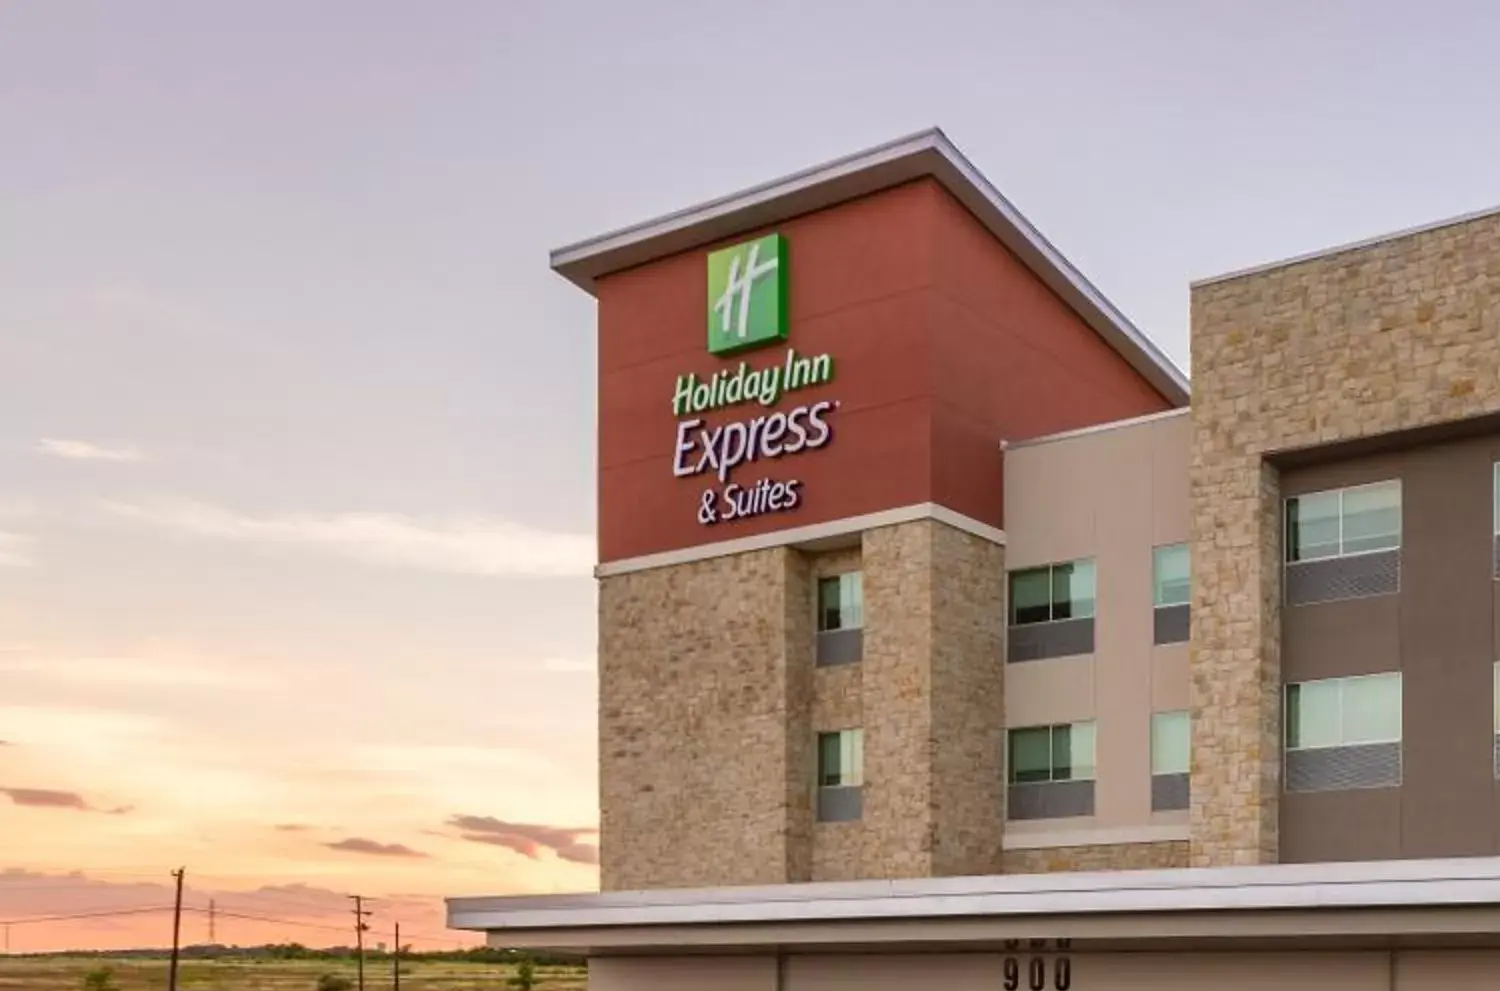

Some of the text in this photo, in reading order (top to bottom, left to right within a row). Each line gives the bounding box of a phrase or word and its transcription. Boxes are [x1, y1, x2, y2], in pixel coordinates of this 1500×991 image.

[714, 244, 779, 338] H
[672, 348, 831, 416] Holiday Inn
[673, 400, 832, 482] Express
[697, 477, 799, 524] & Suites
[1003, 956, 1071, 991] 900
